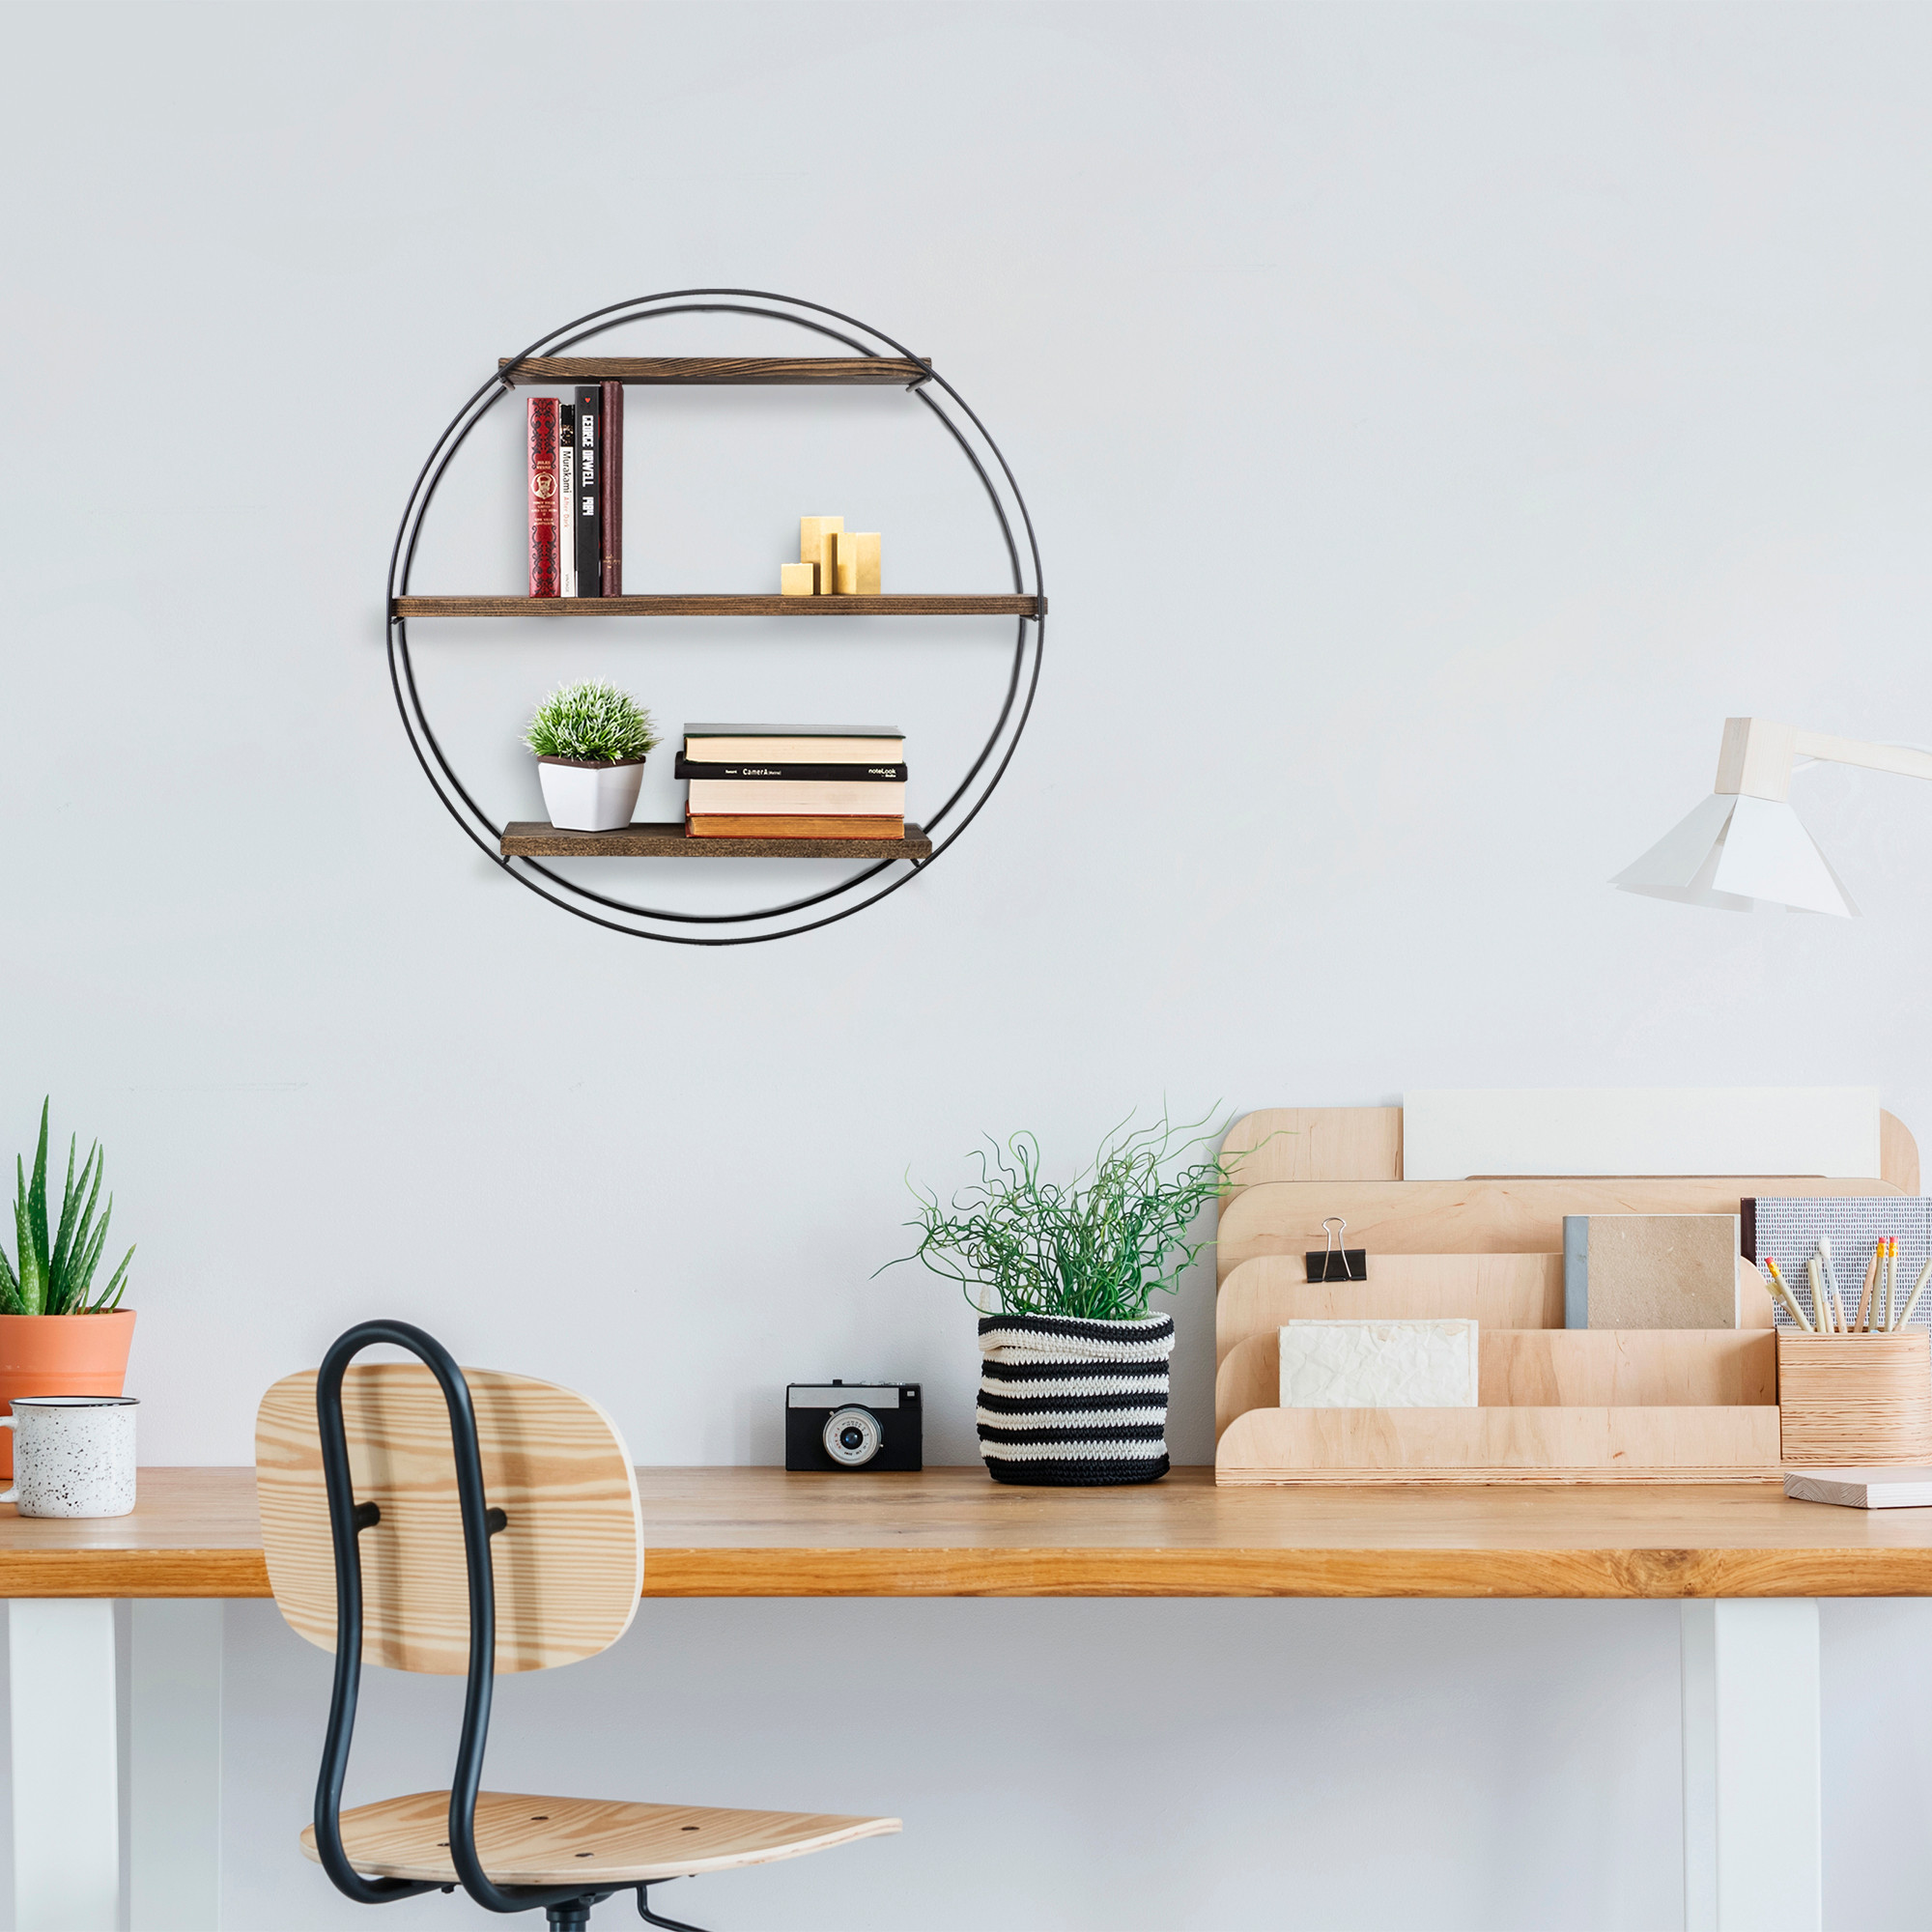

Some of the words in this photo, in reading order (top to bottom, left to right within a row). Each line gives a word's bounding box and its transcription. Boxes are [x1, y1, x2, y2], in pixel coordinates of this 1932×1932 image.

[582, 414, 594, 447] GEORGE
[562, 451, 572, 494] Murakami
[582, 449, 594, 487] ORWELL
[582, 496, 594, 516] 1984
